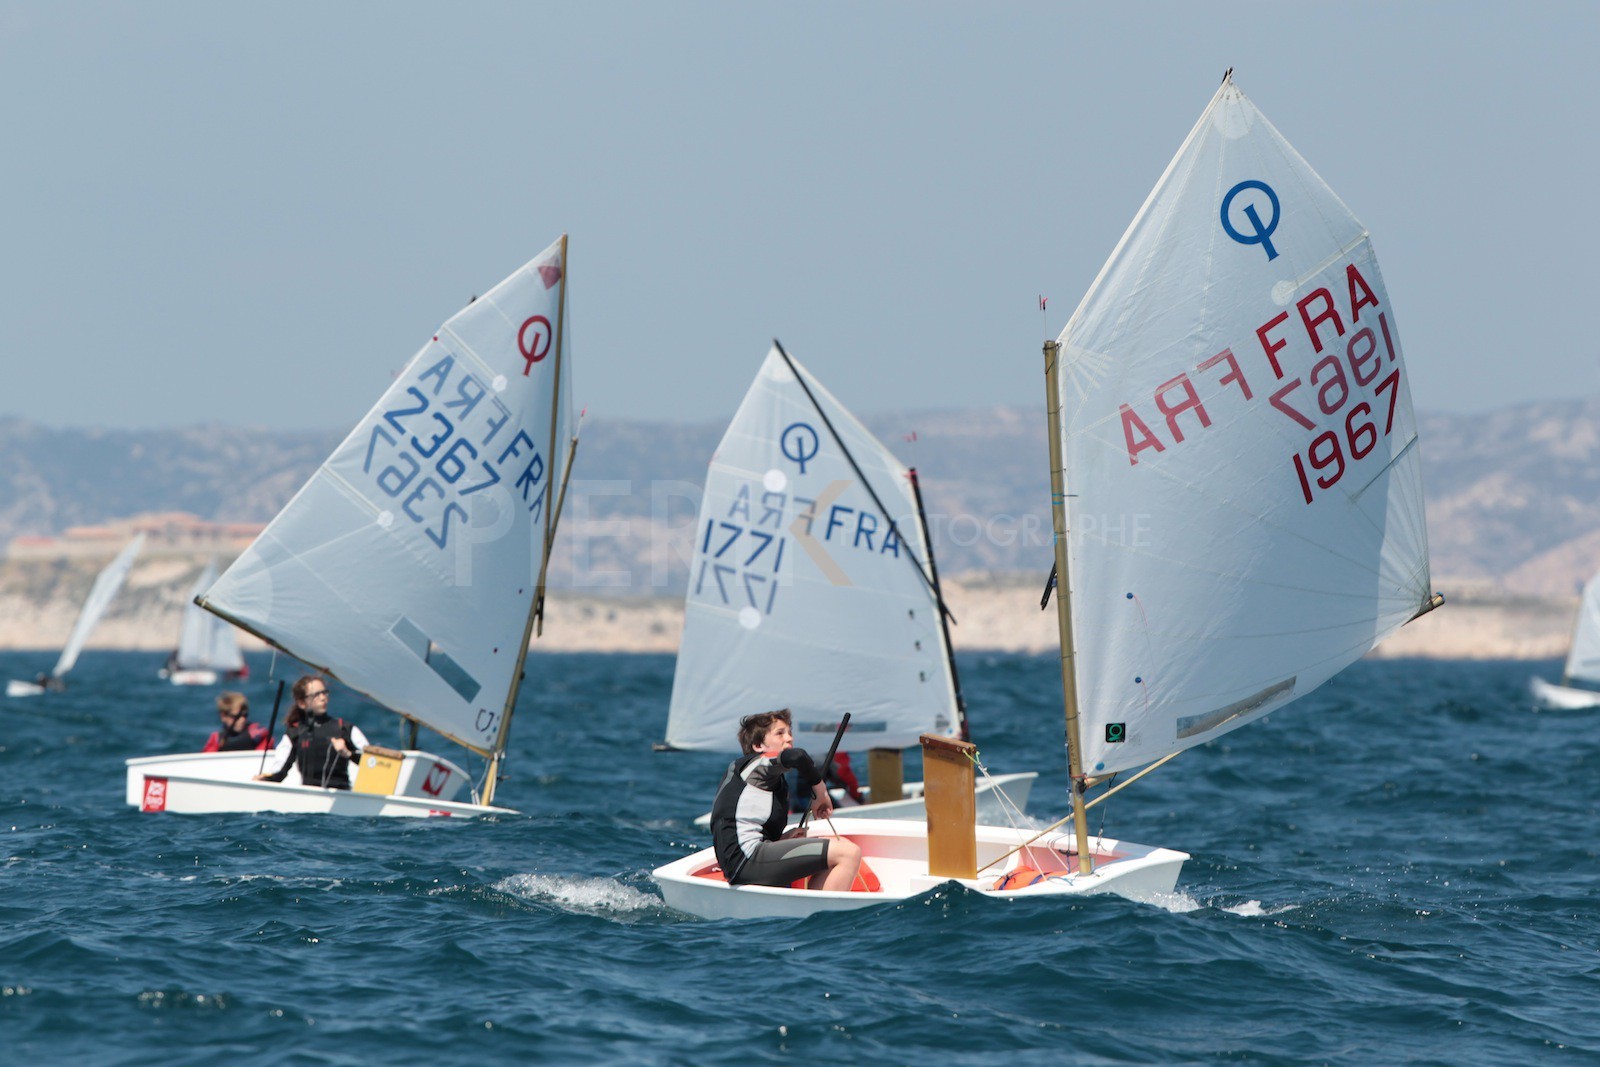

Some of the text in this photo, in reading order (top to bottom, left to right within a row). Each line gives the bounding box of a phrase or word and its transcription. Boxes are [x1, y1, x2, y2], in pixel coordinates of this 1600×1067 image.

[1256, 263, 1379, 380] FRA
[383, 386, 501, 496] 2367
[1292, 367, 1400, 505] 1967
[702, 518, 785, 573] 1771
[825, 505, 900, 558] FRA
